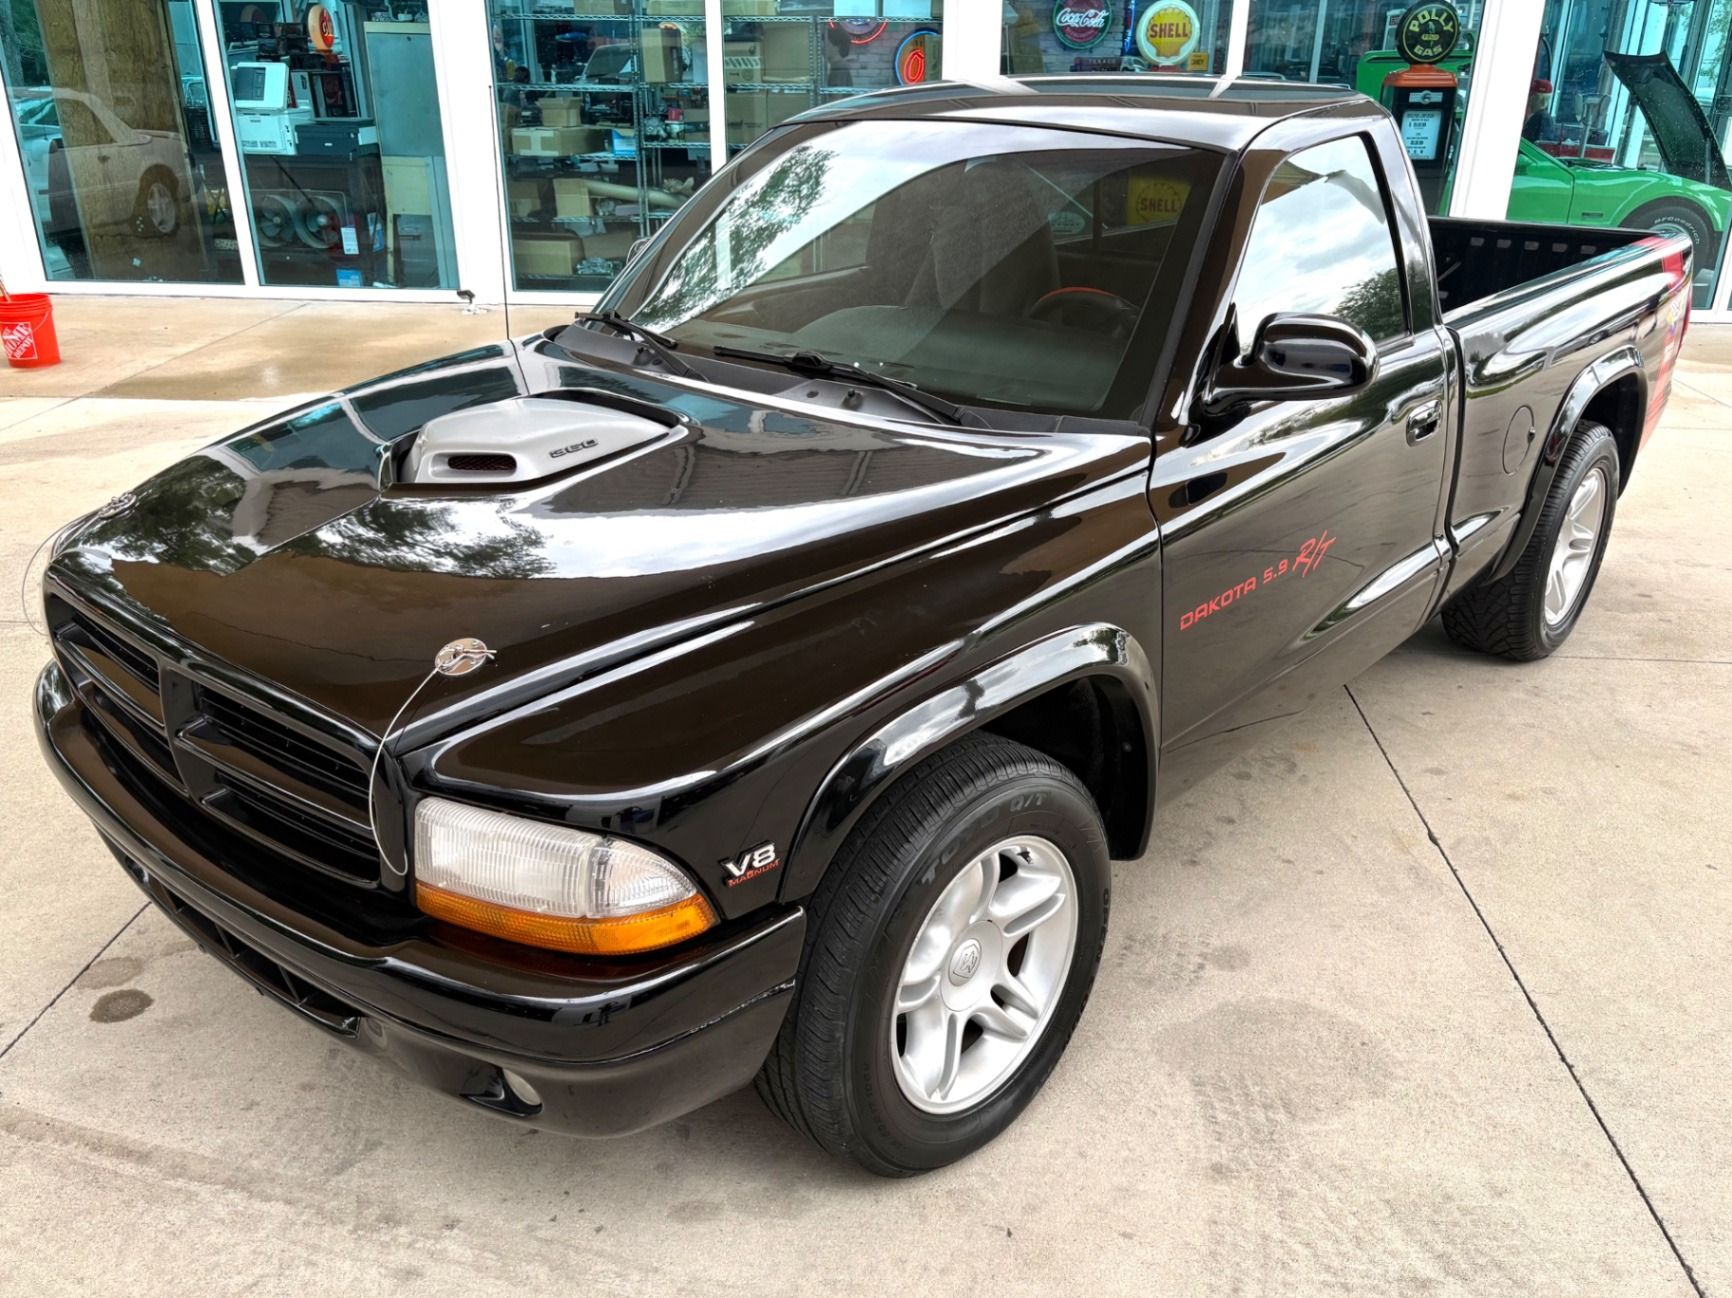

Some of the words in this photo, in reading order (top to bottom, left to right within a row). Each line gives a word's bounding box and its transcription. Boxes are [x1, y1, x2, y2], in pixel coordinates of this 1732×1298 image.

[1056, 8, 1109, 28] Coca-Cola
[1409, 8, 1453, 32] POLLY
[1149, 22, 1188, 38] SHELL
[1414, 45, 1442, 56] GAS
[1140, 197, 1178, 213] SHELL
[1179, 576, 1257, 631] DAKOTA
[1263, 558, 1289, 585] 5.9
[1292, 529, 1337, 578] R/T
[724, 842, 776, 877] V8
[728, 858, 780, 887] MAGNUM
